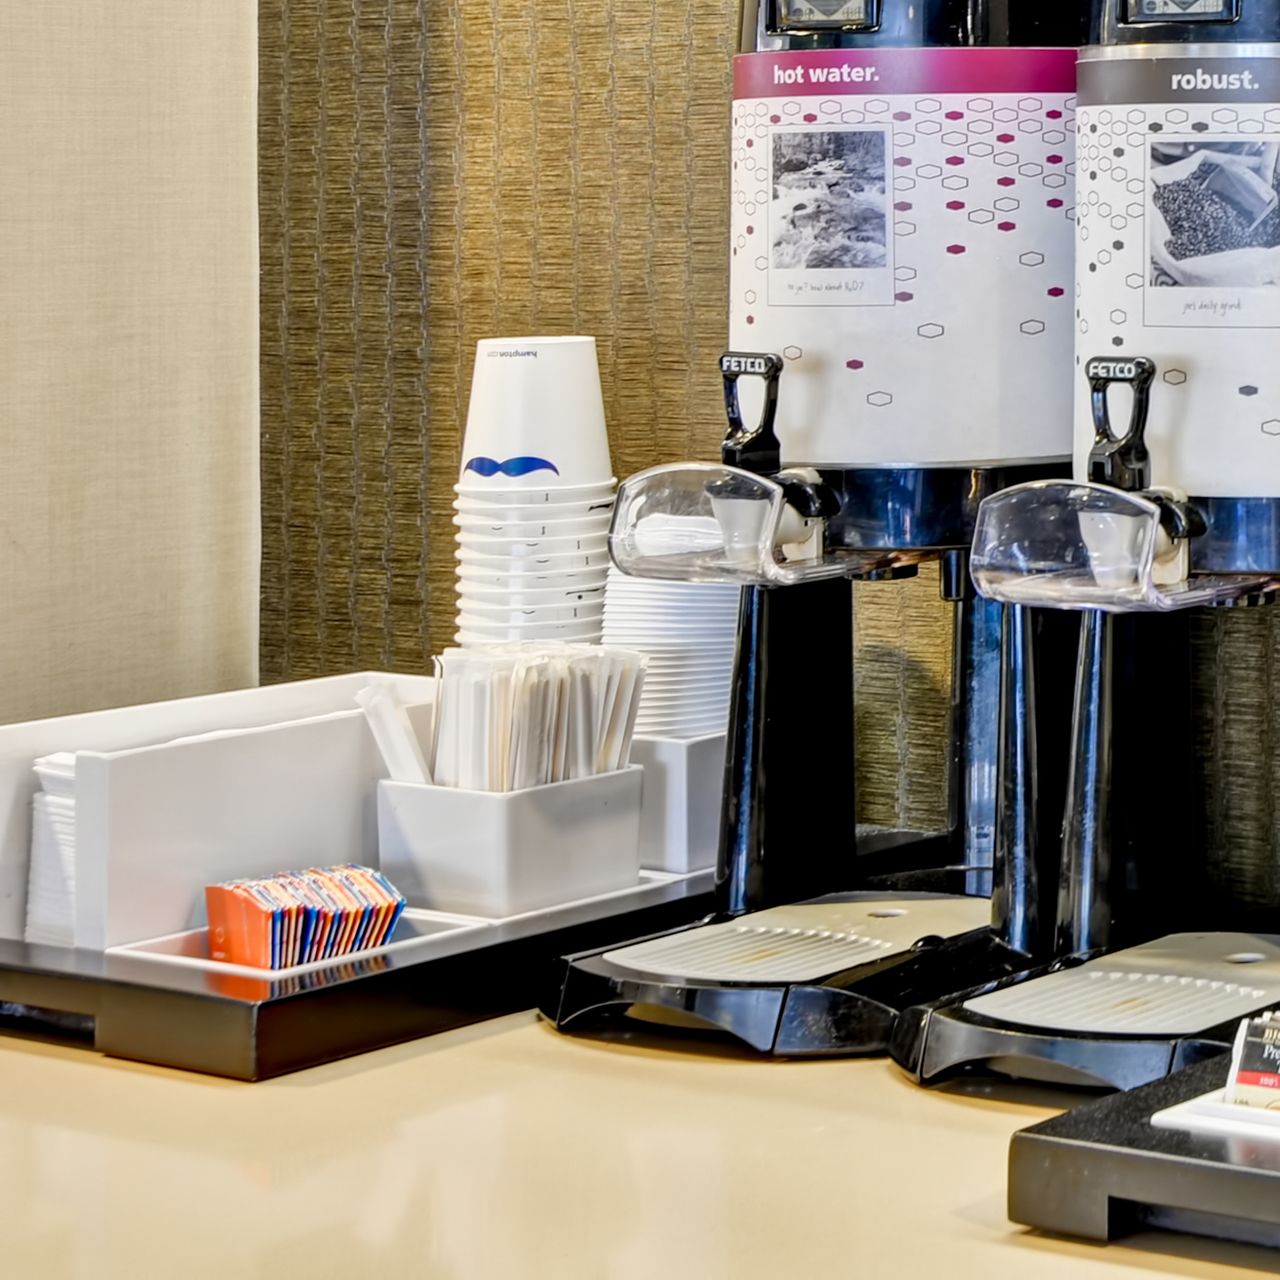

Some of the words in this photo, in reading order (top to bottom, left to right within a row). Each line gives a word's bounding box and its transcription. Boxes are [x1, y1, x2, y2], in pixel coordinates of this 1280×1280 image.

[773, 64, 805, 85] hot
[808, 62, 880, 83] water.
[1171, 67, 1260, 90] robust.
[722, 355, 767, 374] FETCO
[1089, 361, 1136, 379] FETCO
